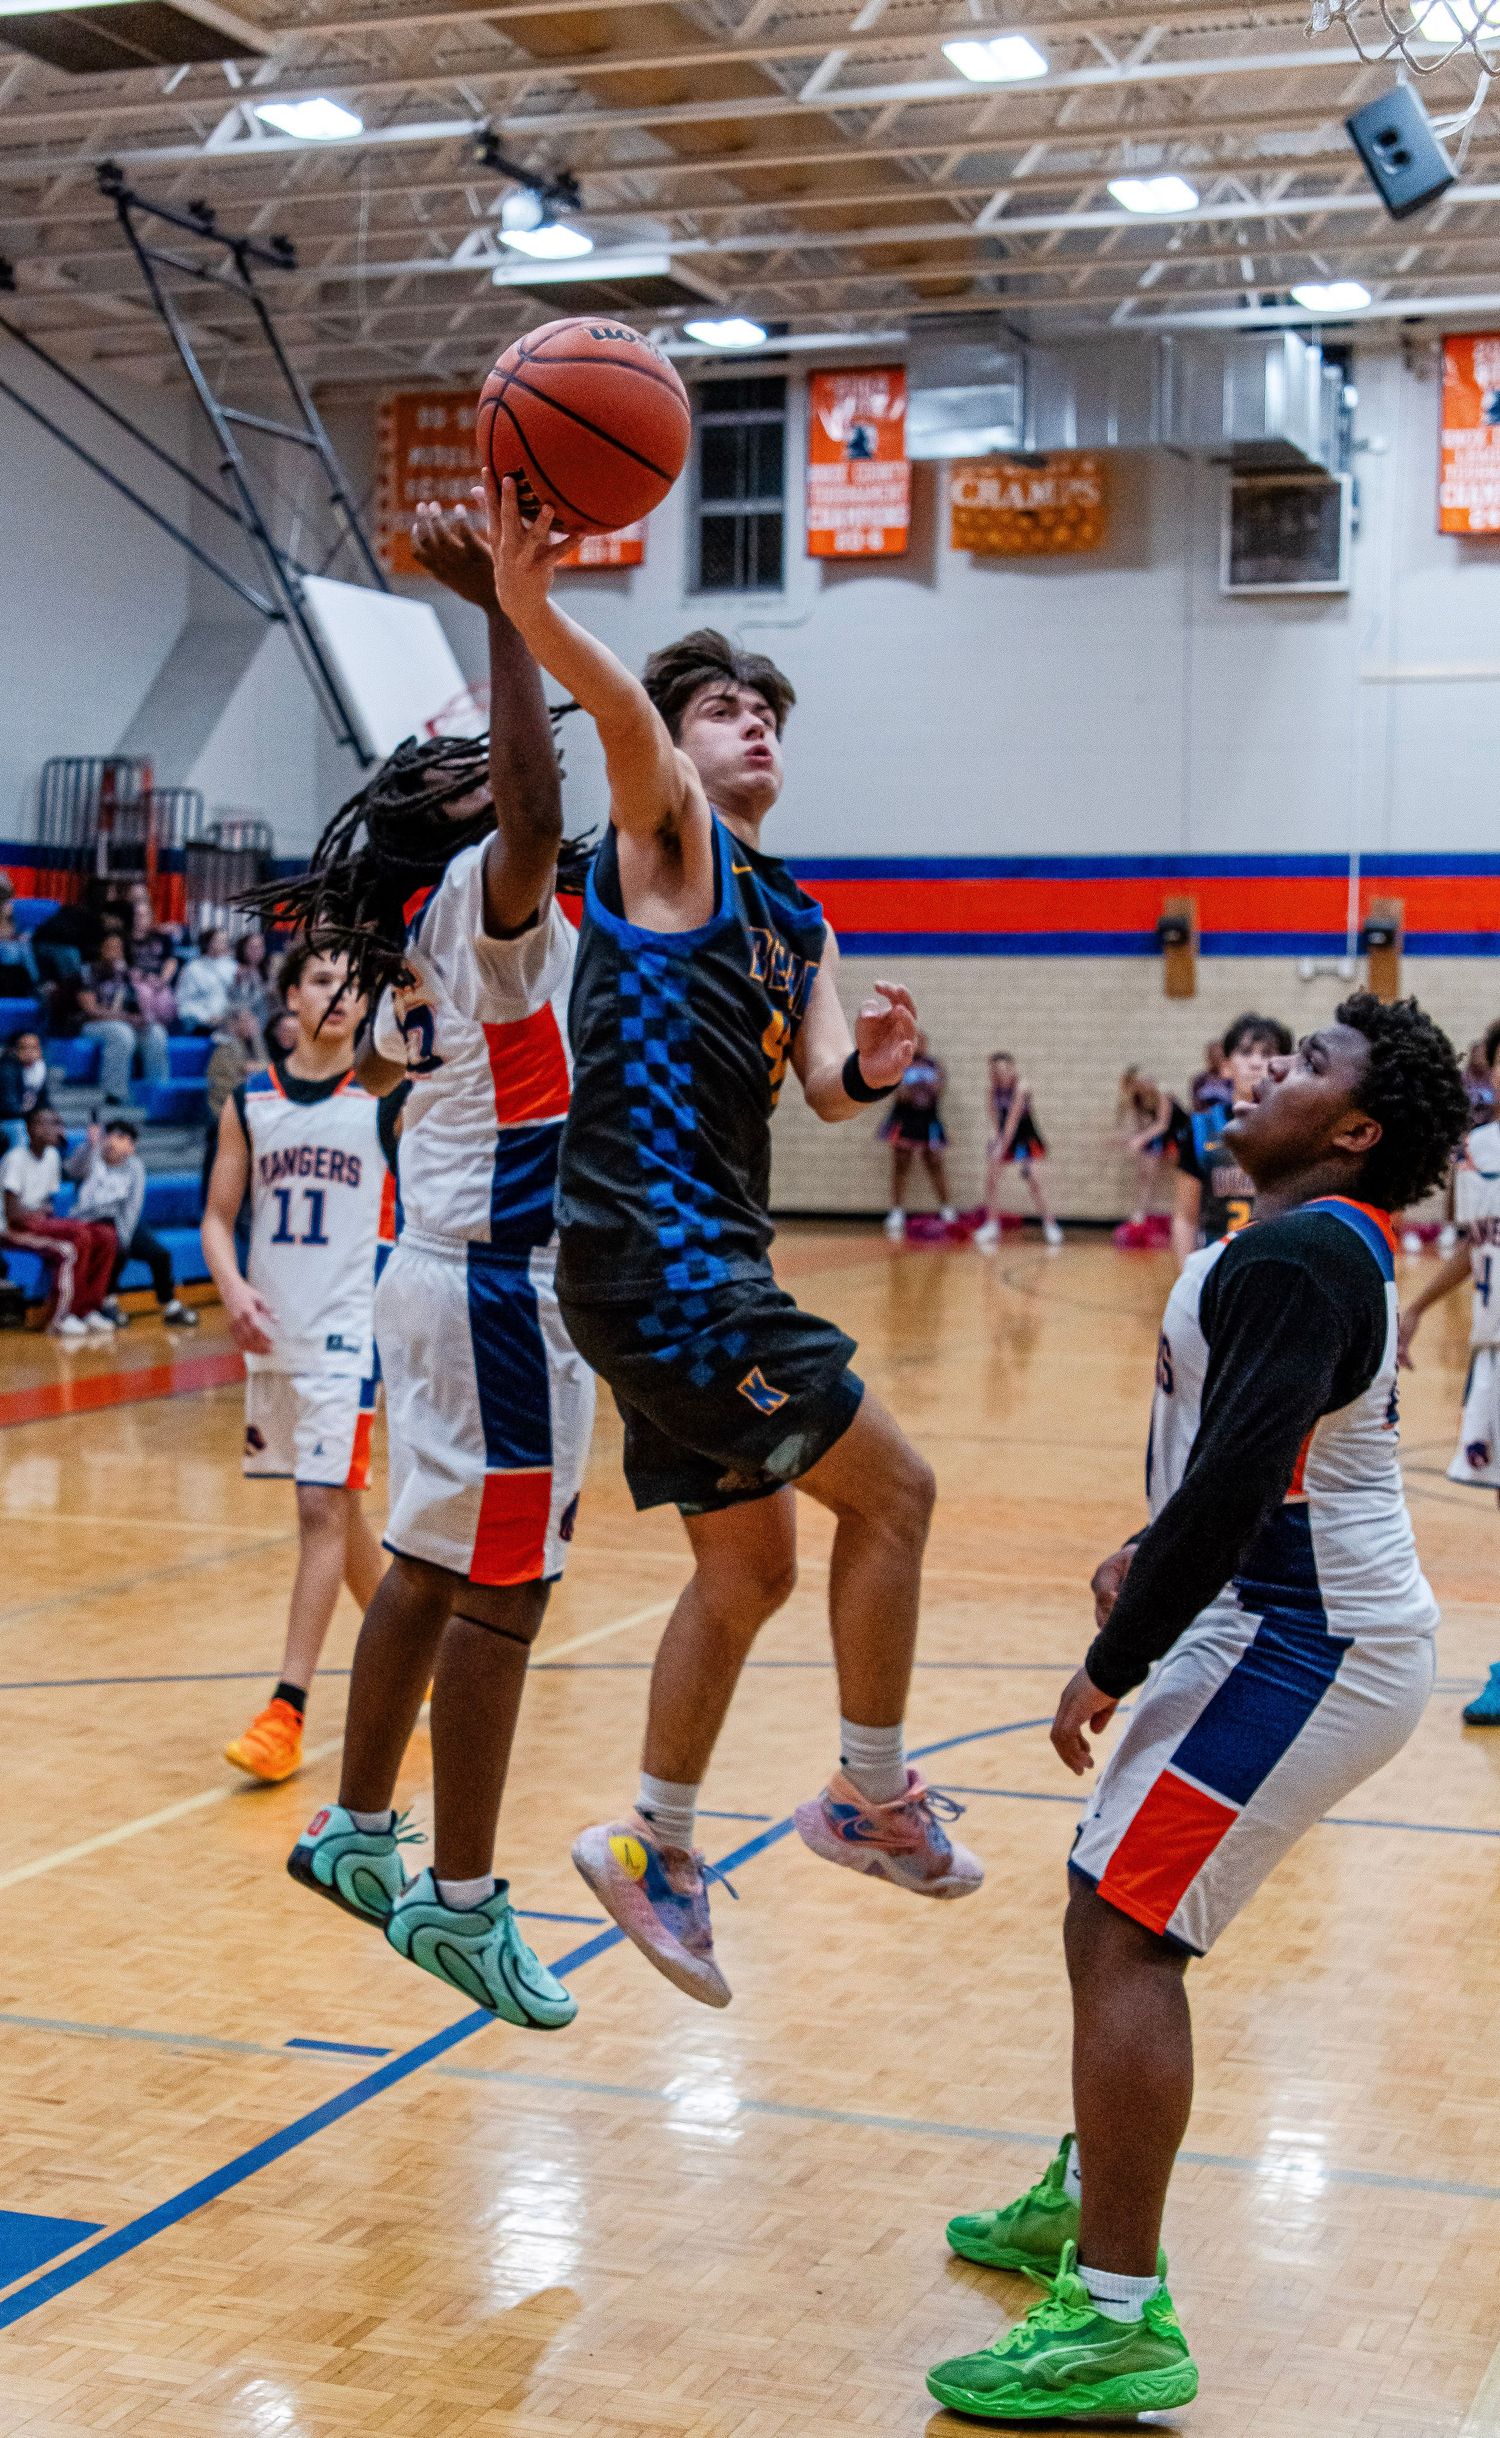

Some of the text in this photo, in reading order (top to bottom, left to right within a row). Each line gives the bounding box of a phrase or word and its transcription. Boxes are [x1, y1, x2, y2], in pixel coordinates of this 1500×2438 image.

[950, 477, 1101, 511] CHAMPS
[271, 1186, 329, 1245] 11
[736, 1366, 789, 1416] K
